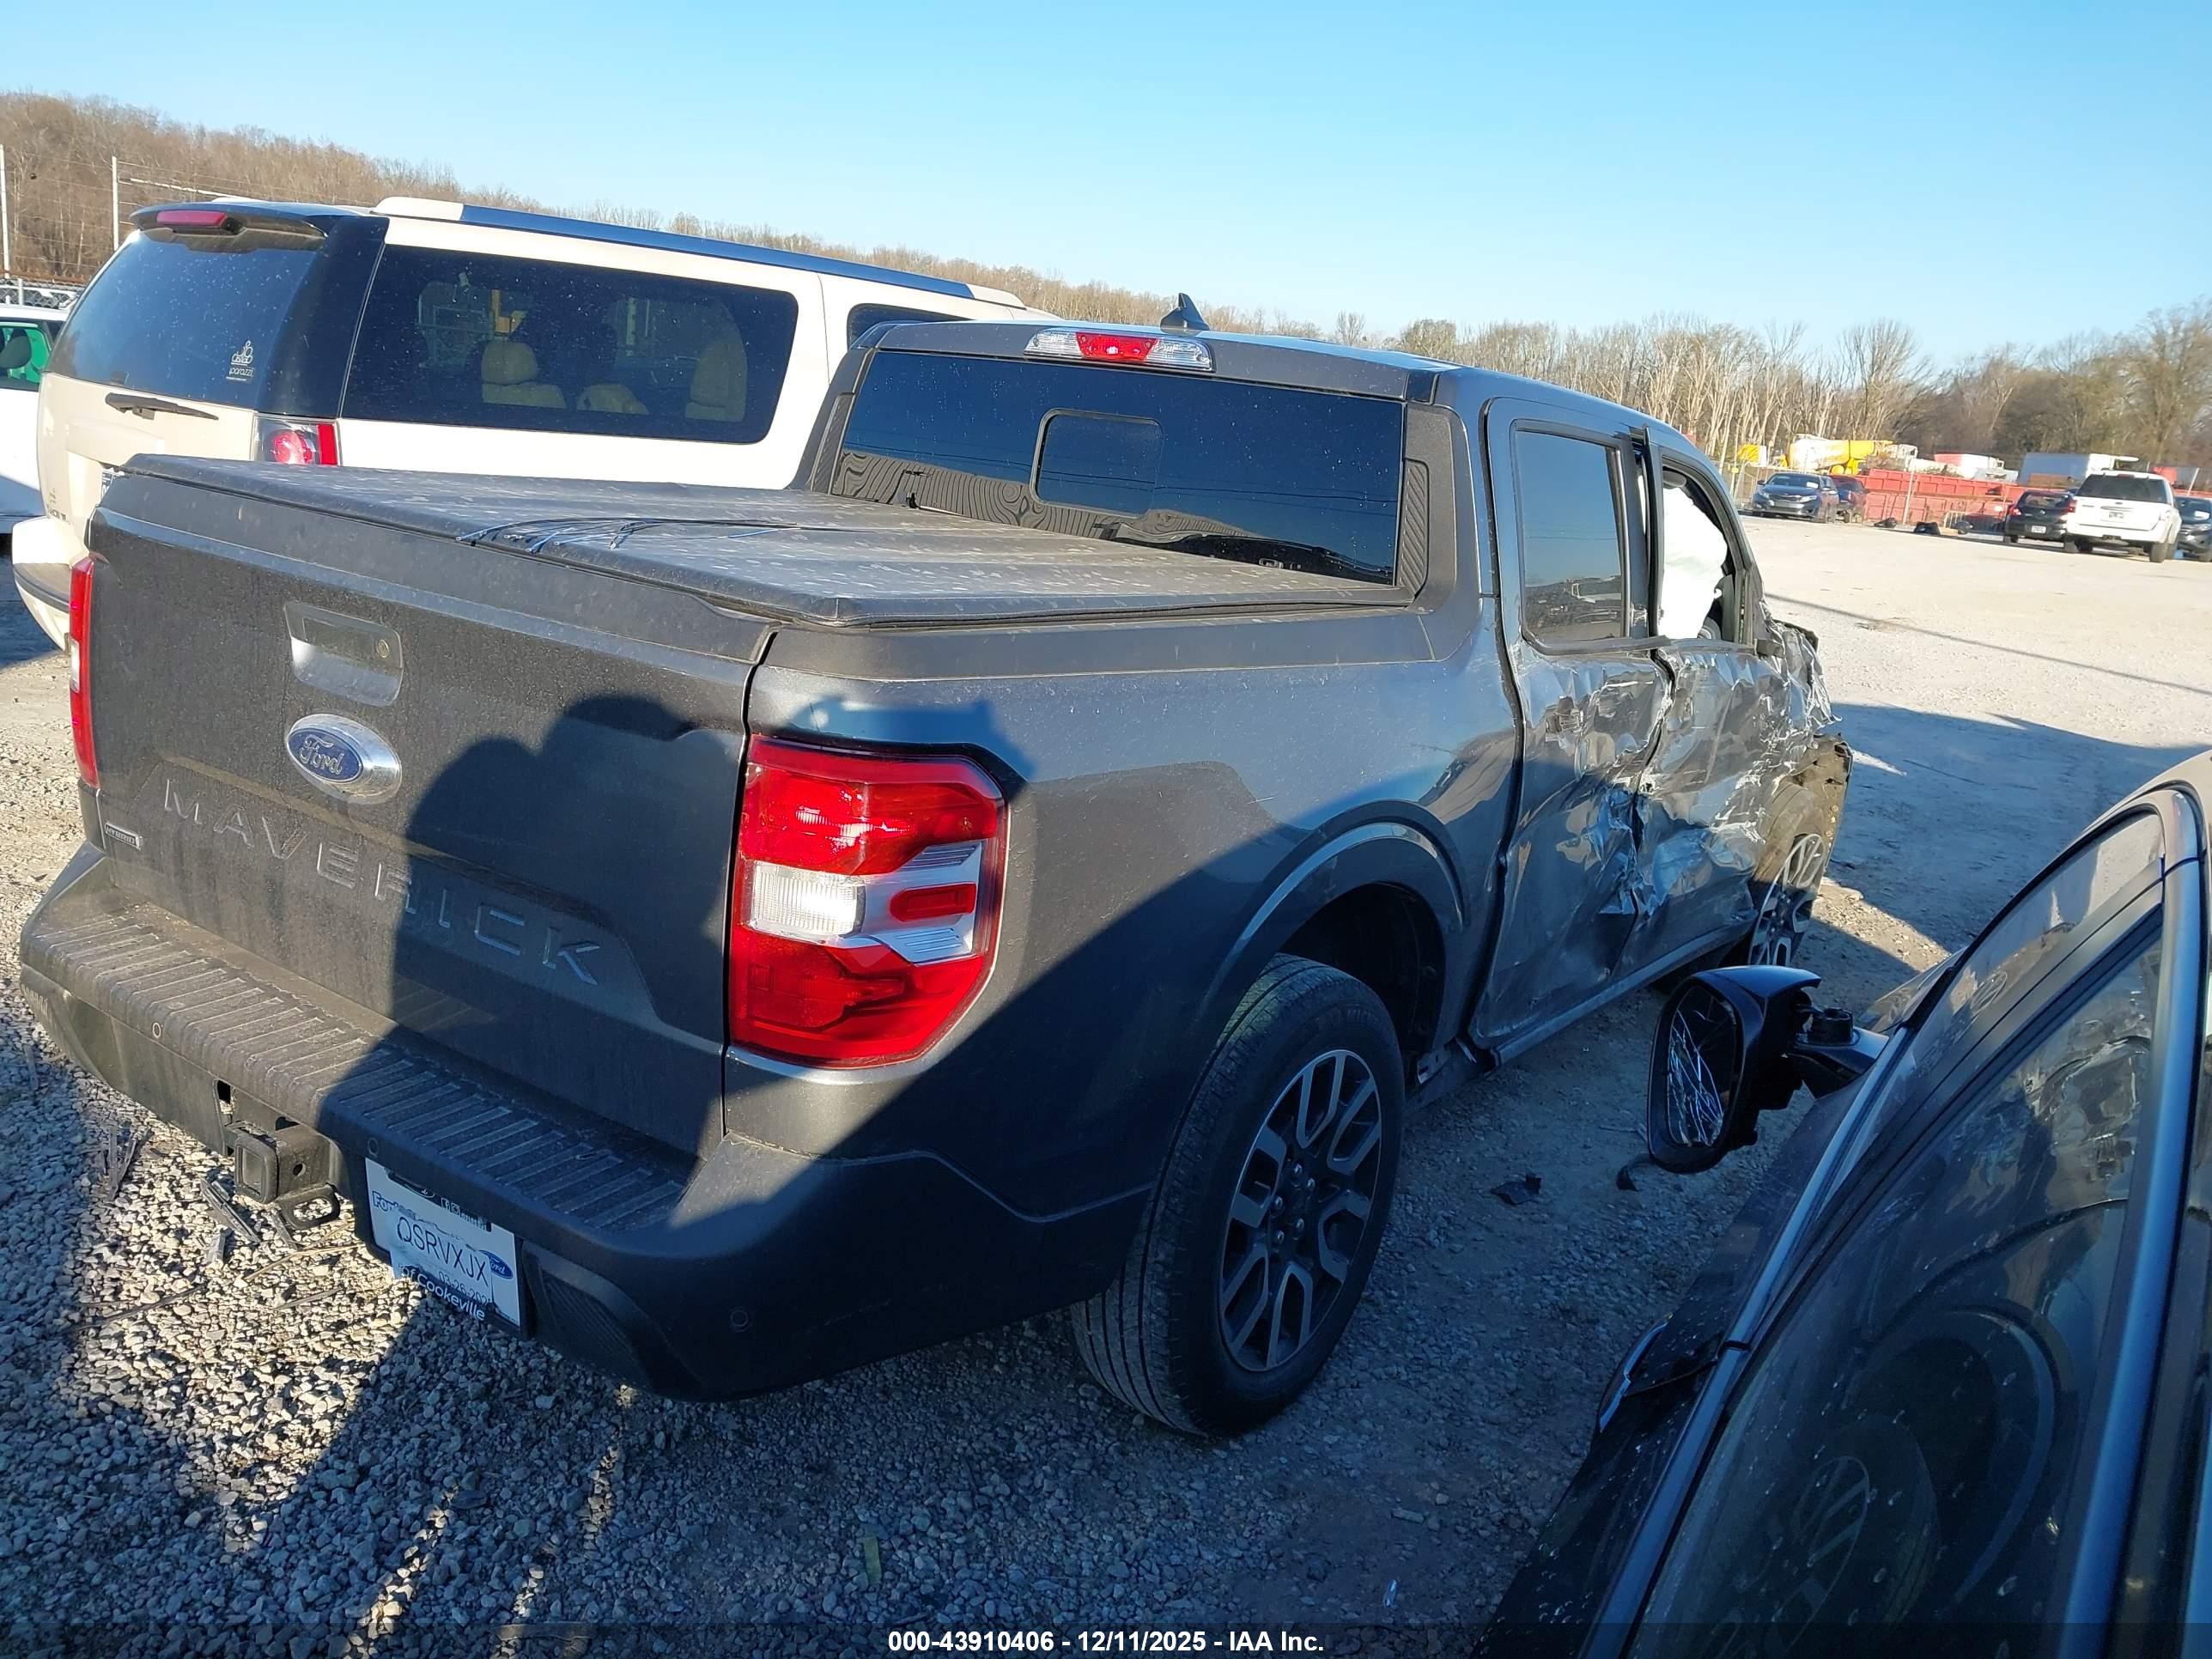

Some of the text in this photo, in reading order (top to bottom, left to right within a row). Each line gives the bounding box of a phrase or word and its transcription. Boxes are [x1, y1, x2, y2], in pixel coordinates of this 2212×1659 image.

[300, 733, 344, 775] Ford
[106, 825, 136, 845] HYBRID
[164, 777, 600, 987] MAVERICK
[397, 1216, 489, 1287] QSRVXJX
[416, 1273, 485, 1322] Cookeville
[439, 1271, 491, 1305] 03-26-202
